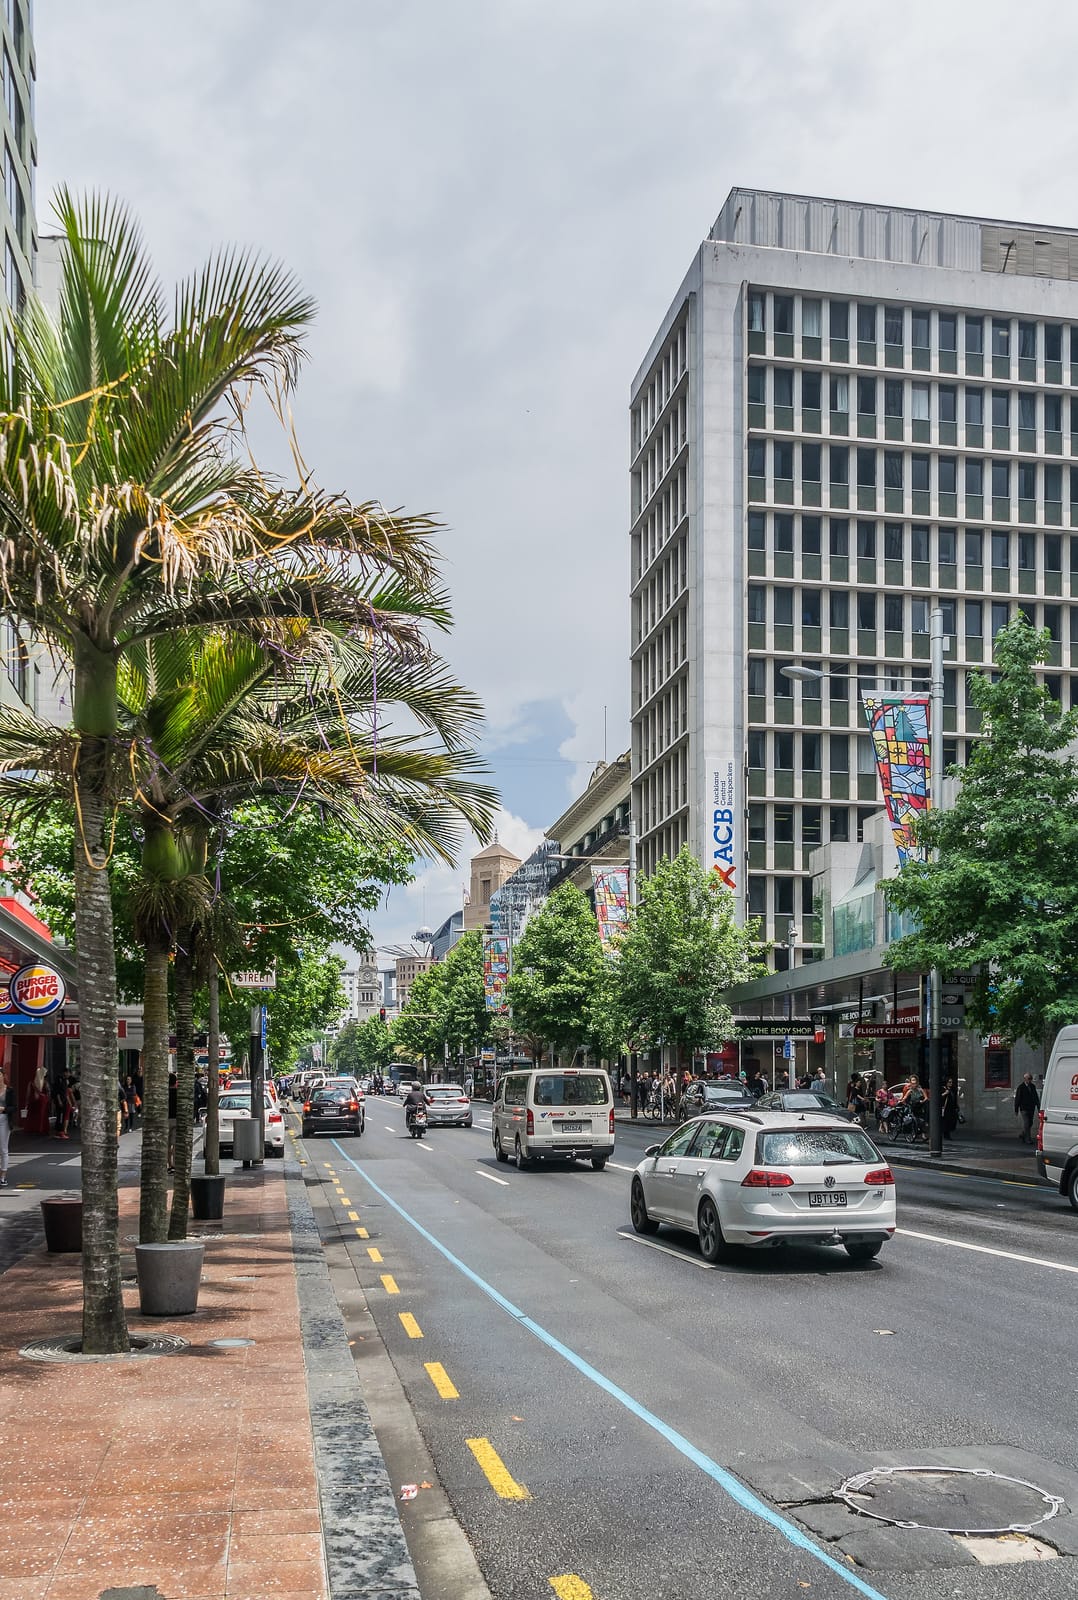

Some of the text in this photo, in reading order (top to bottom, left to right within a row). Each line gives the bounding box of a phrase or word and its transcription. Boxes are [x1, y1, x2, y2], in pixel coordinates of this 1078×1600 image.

[713, 809, 733, 865] ACB
[17, 975, 57, 990] BURGER
[18, 984, 58, 1003] KING
[941, 1017, 960, 1026] OJO
[755, 1027, 769, 1035] THE
[771, 1027, 791, 1035] BODY
[857, 1027, 915, 1035] FLIGHT CENTRE
[811, 1193, 845, 1205] JBT196
